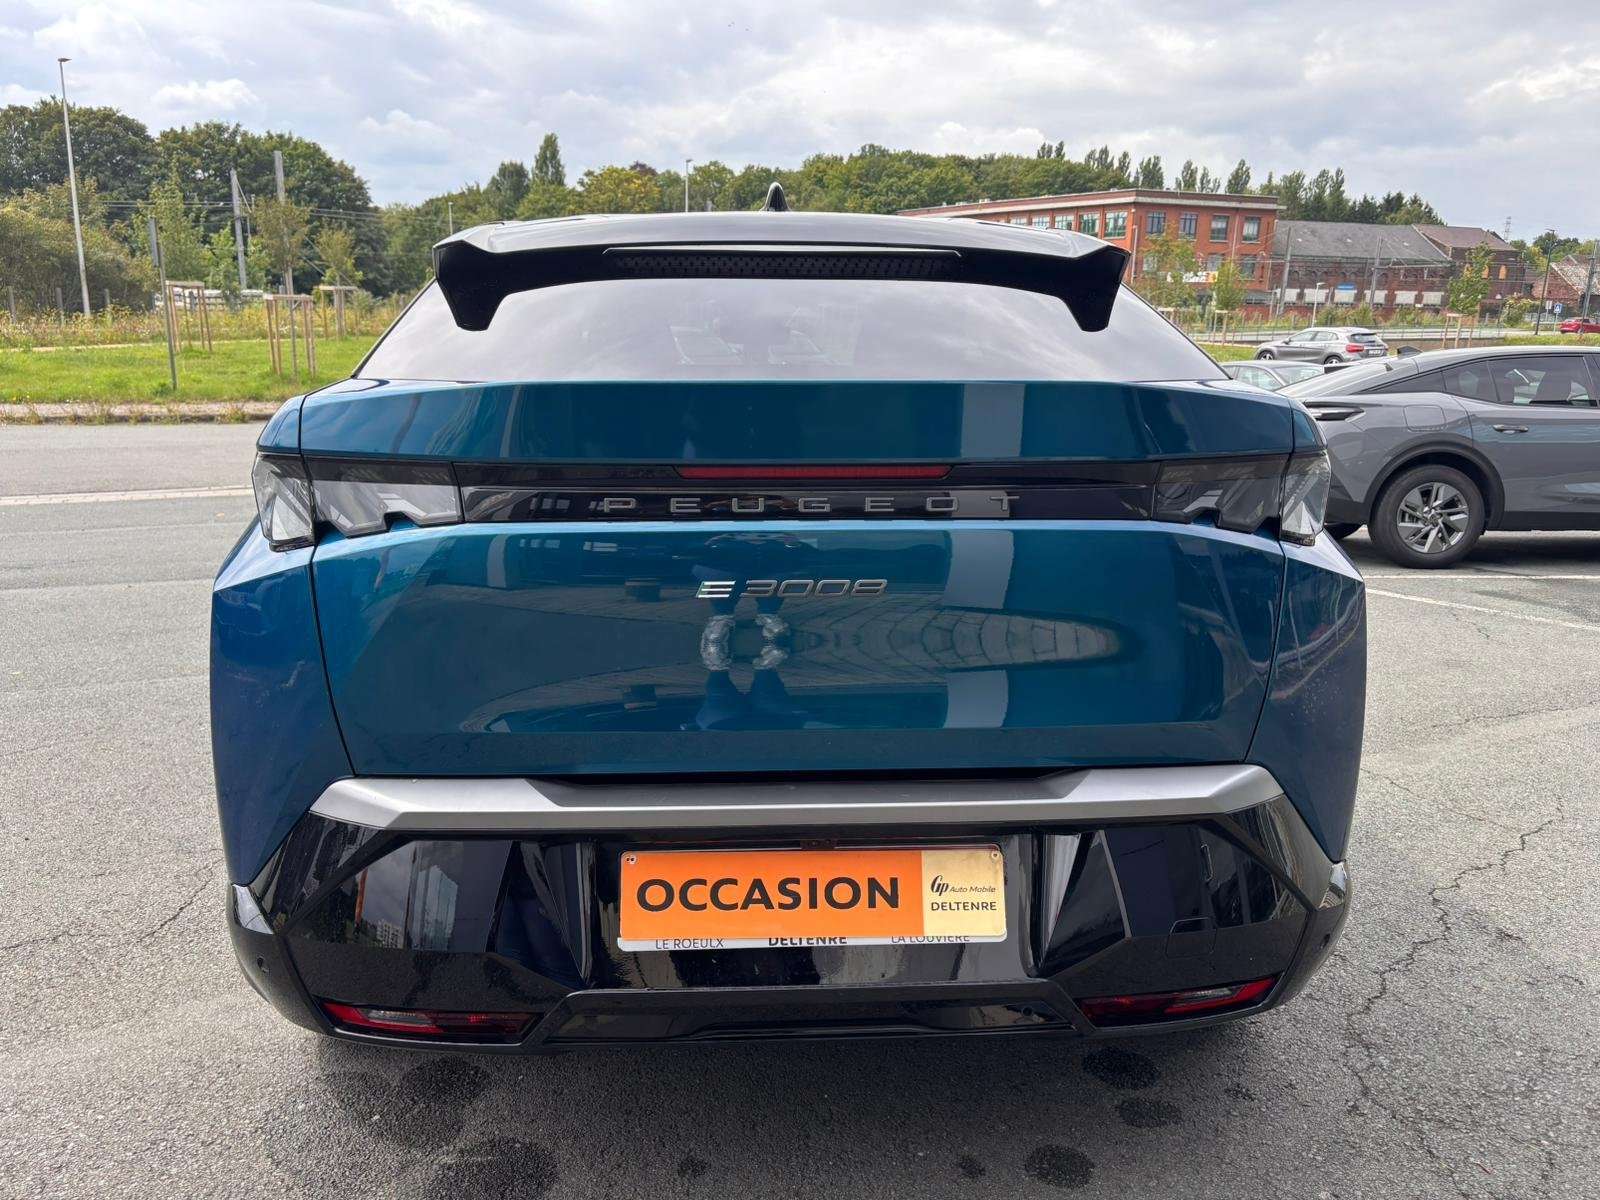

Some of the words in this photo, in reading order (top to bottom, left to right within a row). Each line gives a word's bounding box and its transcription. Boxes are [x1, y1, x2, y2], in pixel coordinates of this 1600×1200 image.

[603, 496, 1020, 513] PEUGEOT
[739, 579, 887, 598] 3008
[636, 877, 899, 912] OCCASION
[969, 885, 996, 893] Mobile
[930, 901, 997, 911] DELTENRE
[655, 939, 670, 949] LE
[673, 938, 724, 949] ROEULX
